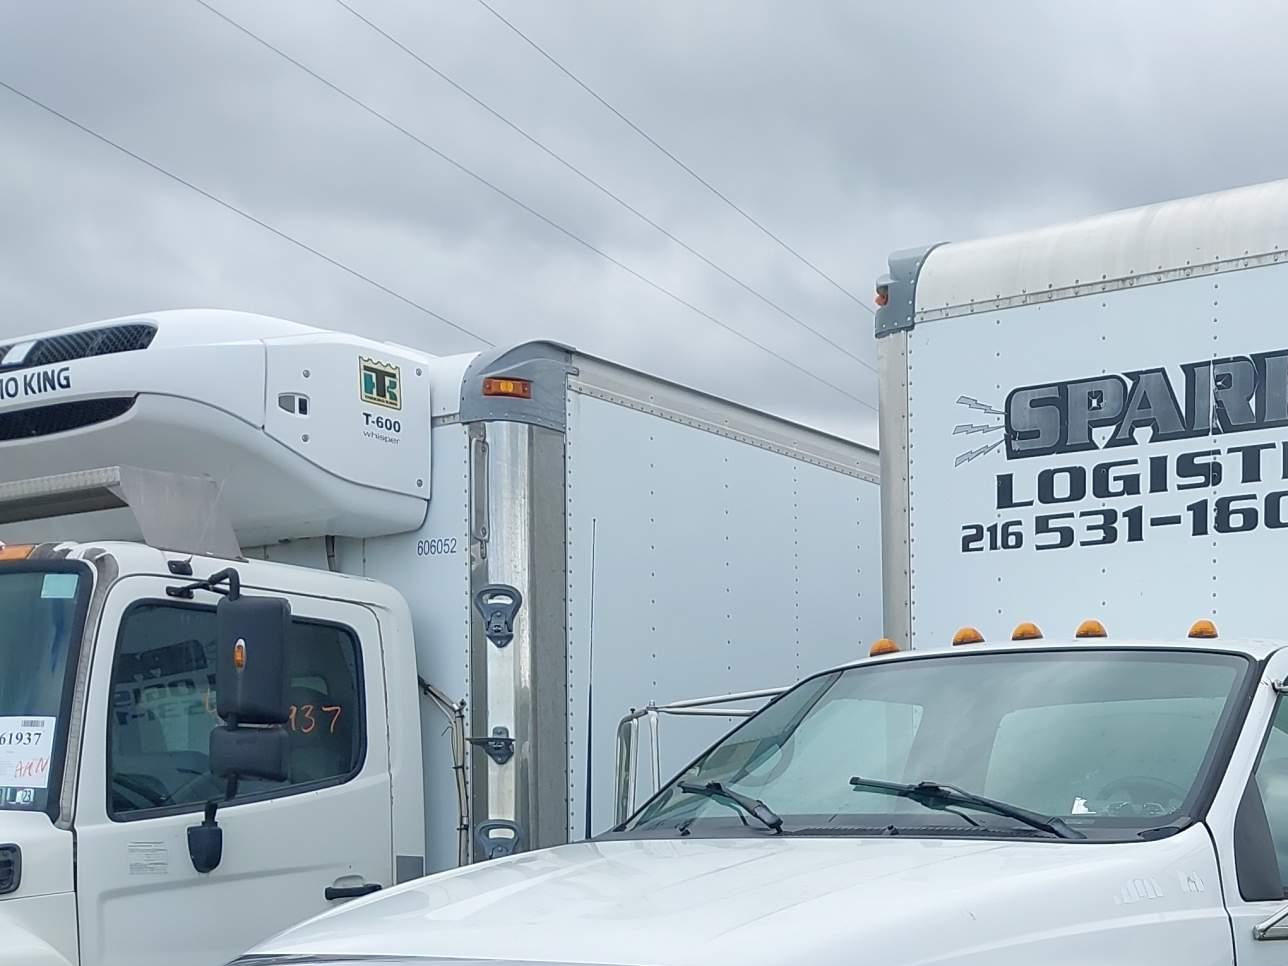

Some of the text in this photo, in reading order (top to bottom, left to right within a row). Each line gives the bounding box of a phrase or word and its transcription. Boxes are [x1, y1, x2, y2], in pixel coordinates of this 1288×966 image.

[23, 366, 71, 396] KING
[362, 412, 401, 433] T-600
[417, 537, 457, 556] 606052
[960, 519, 1024, 553] 216
